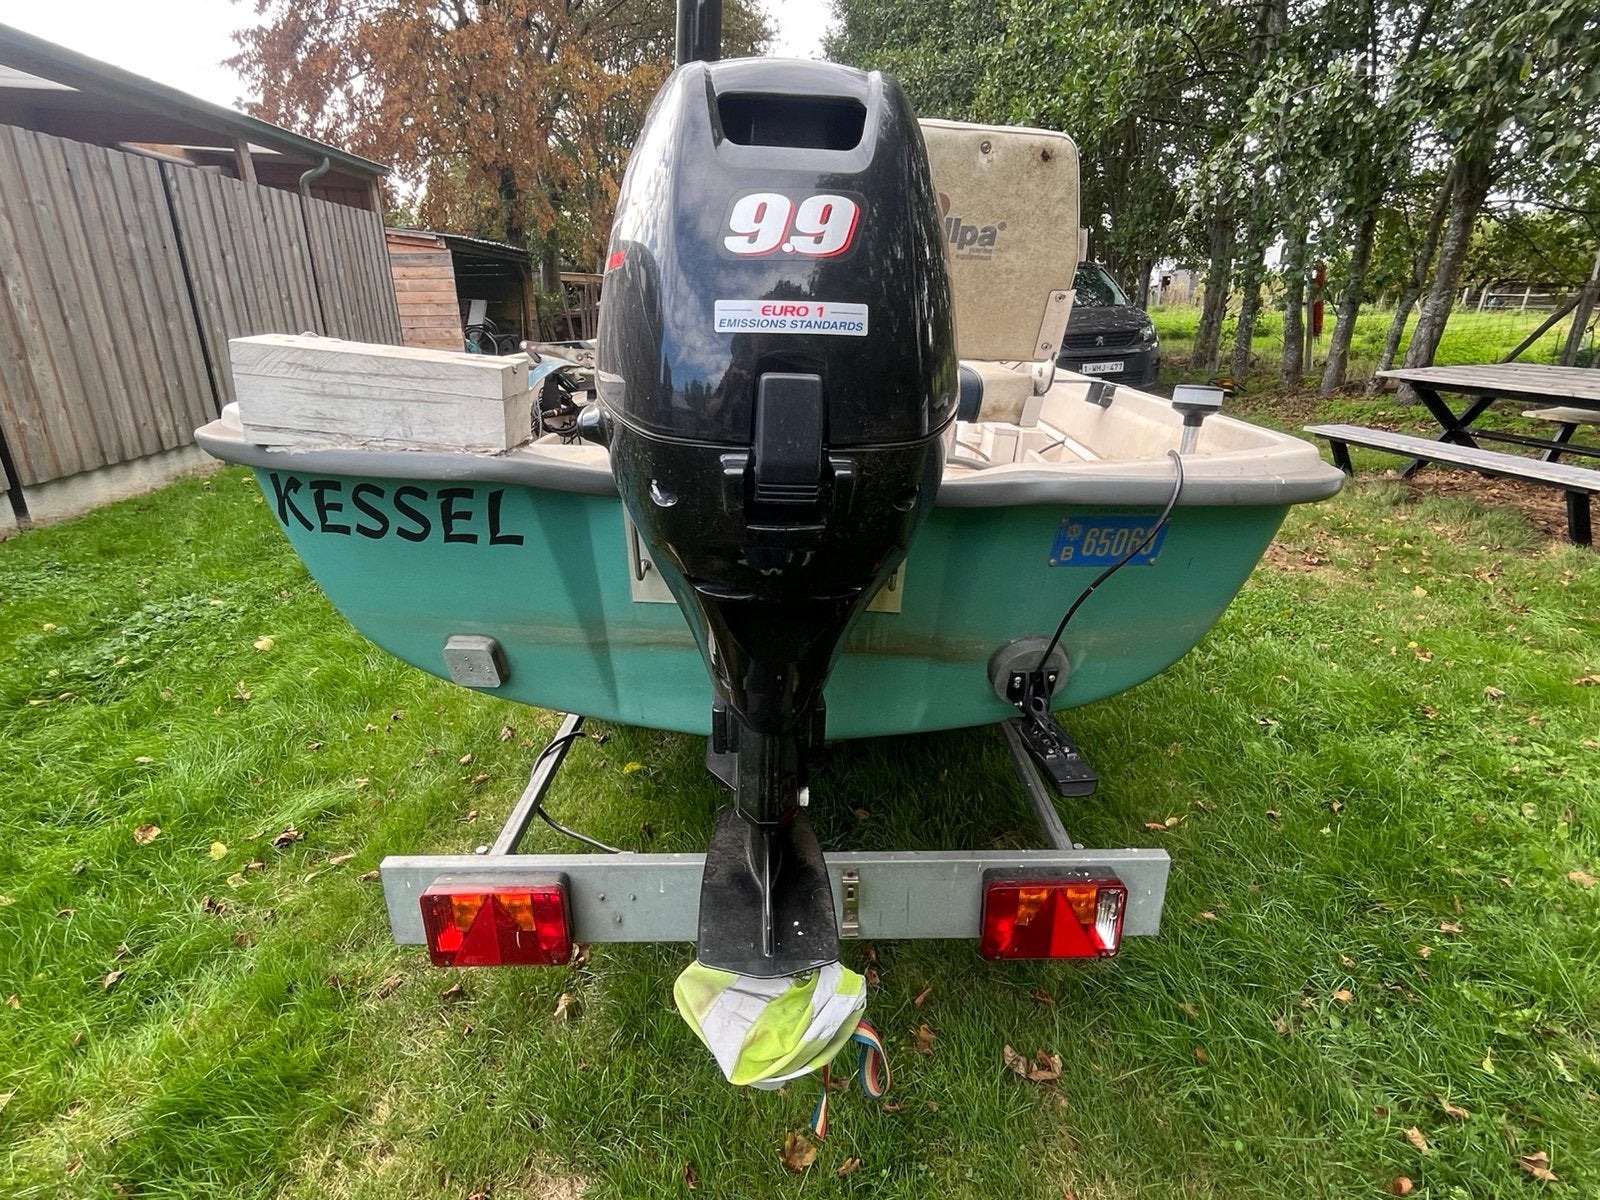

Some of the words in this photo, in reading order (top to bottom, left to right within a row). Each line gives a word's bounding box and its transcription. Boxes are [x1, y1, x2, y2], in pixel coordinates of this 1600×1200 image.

[724, 192, 860, 258] 9.9
[945, 217, 998, 249] llpa
[761, 304, 809, 317] EURO
[816, 306, 825, 318] 1
[719, 318, 787, 329] EMISSIONS
[790, 320, 864, 332] STANDARDS
[270, 472, 525, 546] KESSEL
[1060, 546, 1074, 561] B
